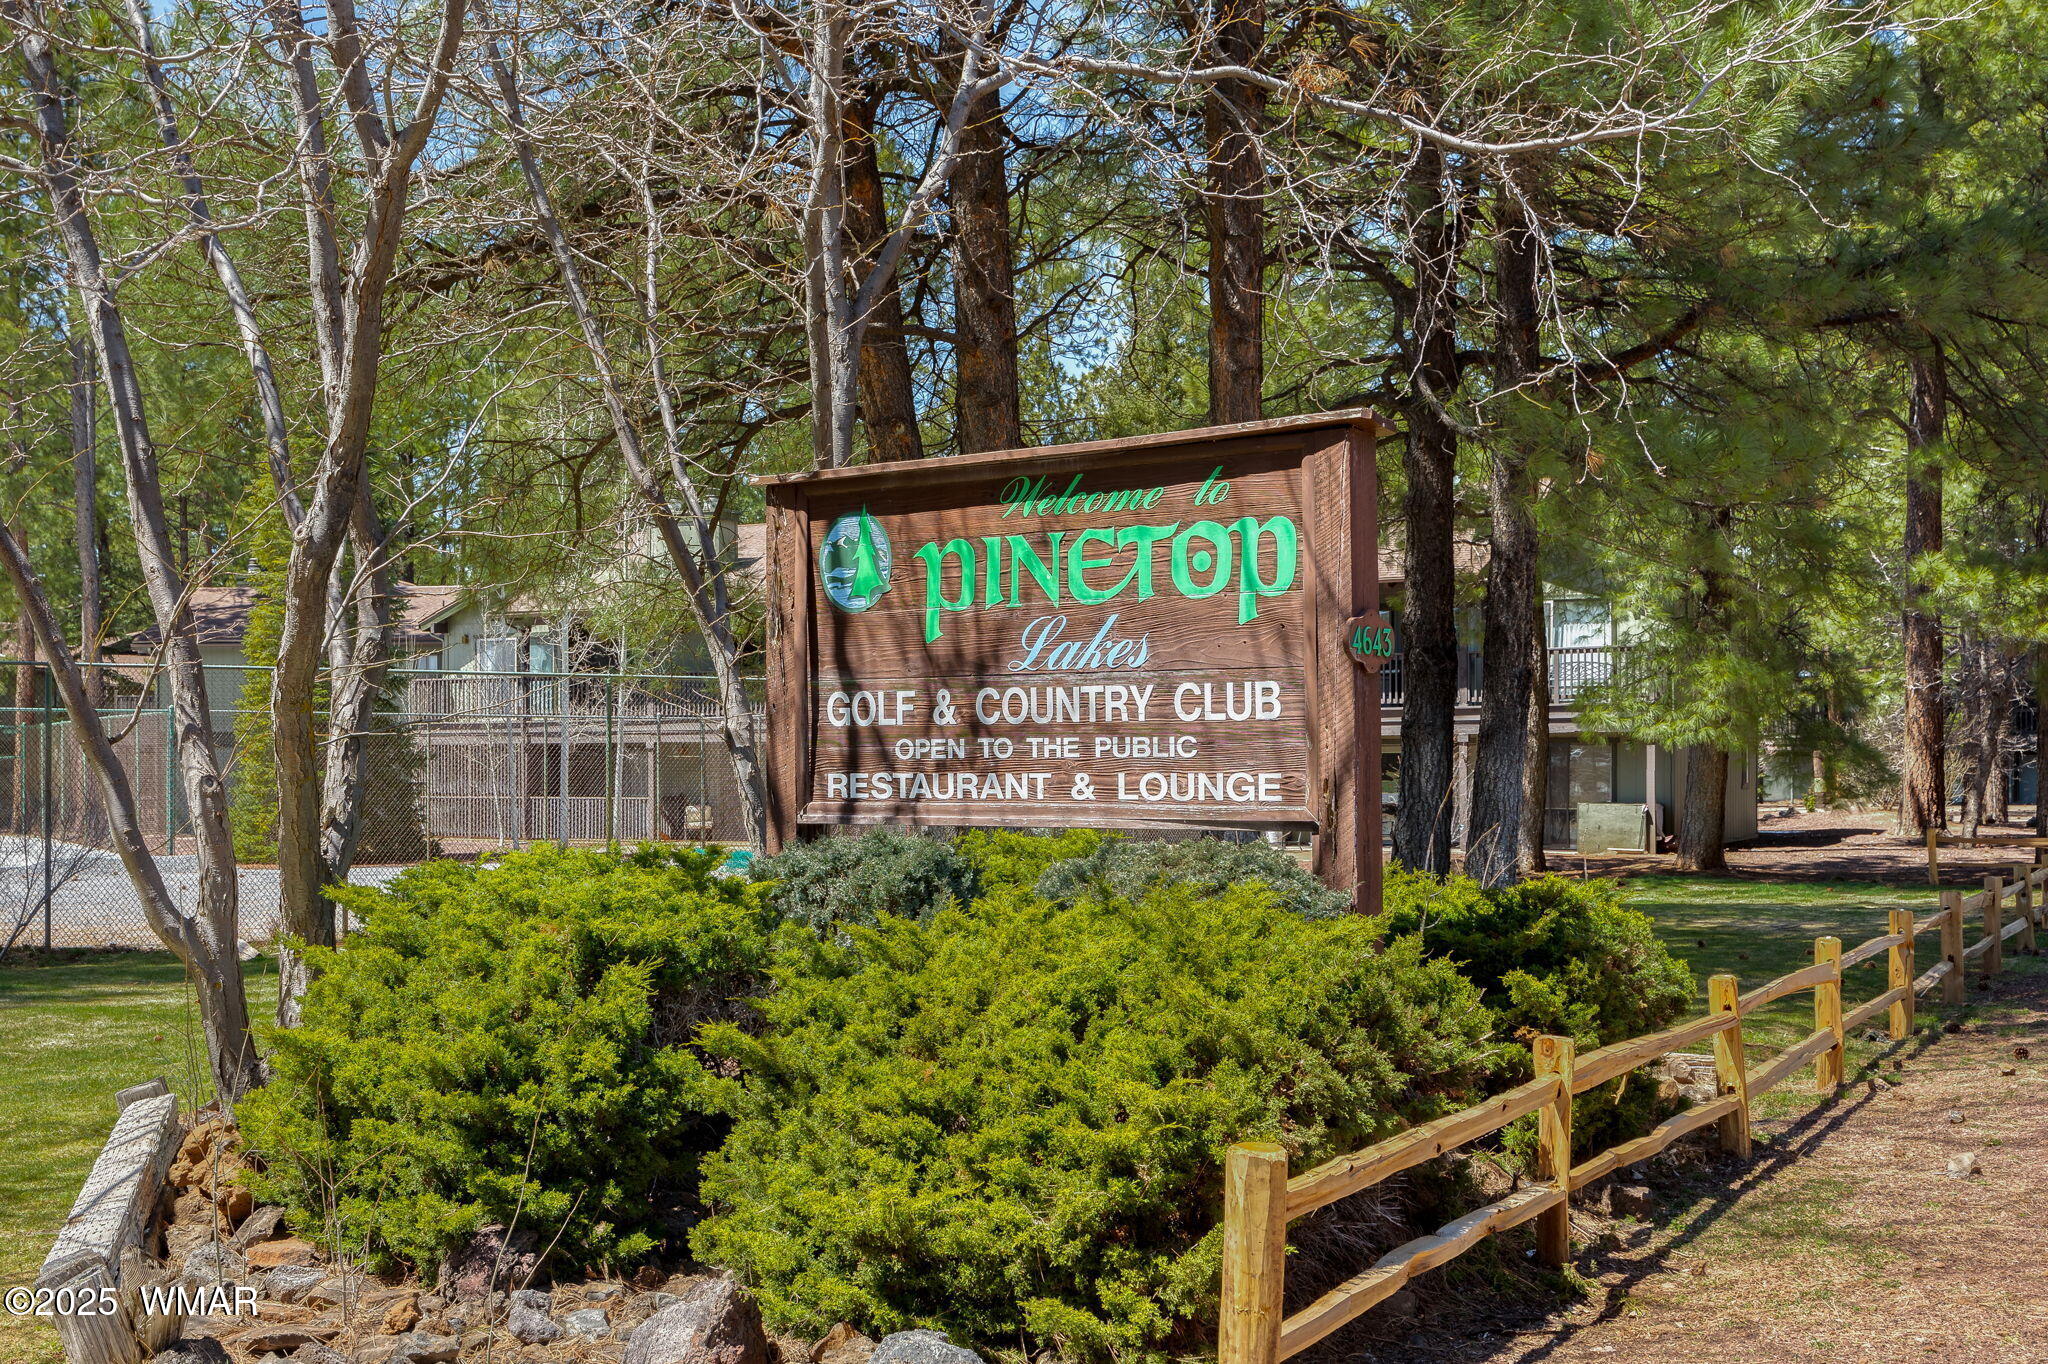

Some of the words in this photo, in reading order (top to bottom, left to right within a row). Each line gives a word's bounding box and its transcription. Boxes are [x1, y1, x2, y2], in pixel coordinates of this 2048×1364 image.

[999, 473, 1165, 519] Welcome
[1193, 465, 1230, 506] to
[1008, 614, 1150, 672] Lakes
[1352, 626, 1392, 657] 4643
[826, 690, 915, 728] GOLF
[933, 688, 957, 726] &
[976, 684, 1154, 726] COUNTRY
[1173, 681, 1282, 721] CLUB
[895, 738, 965, 760] OPEN
[978, 738, 1013, 759] TO
[1025, 737, 1079, 759] THE
[1095, 736, 1199, 759] PUBLIC
[826, 772, 1052, 801] RESTAURANT
[1070, 772, 1096, 800] &
[1117, 772, 1283, 802] LOUNGE
